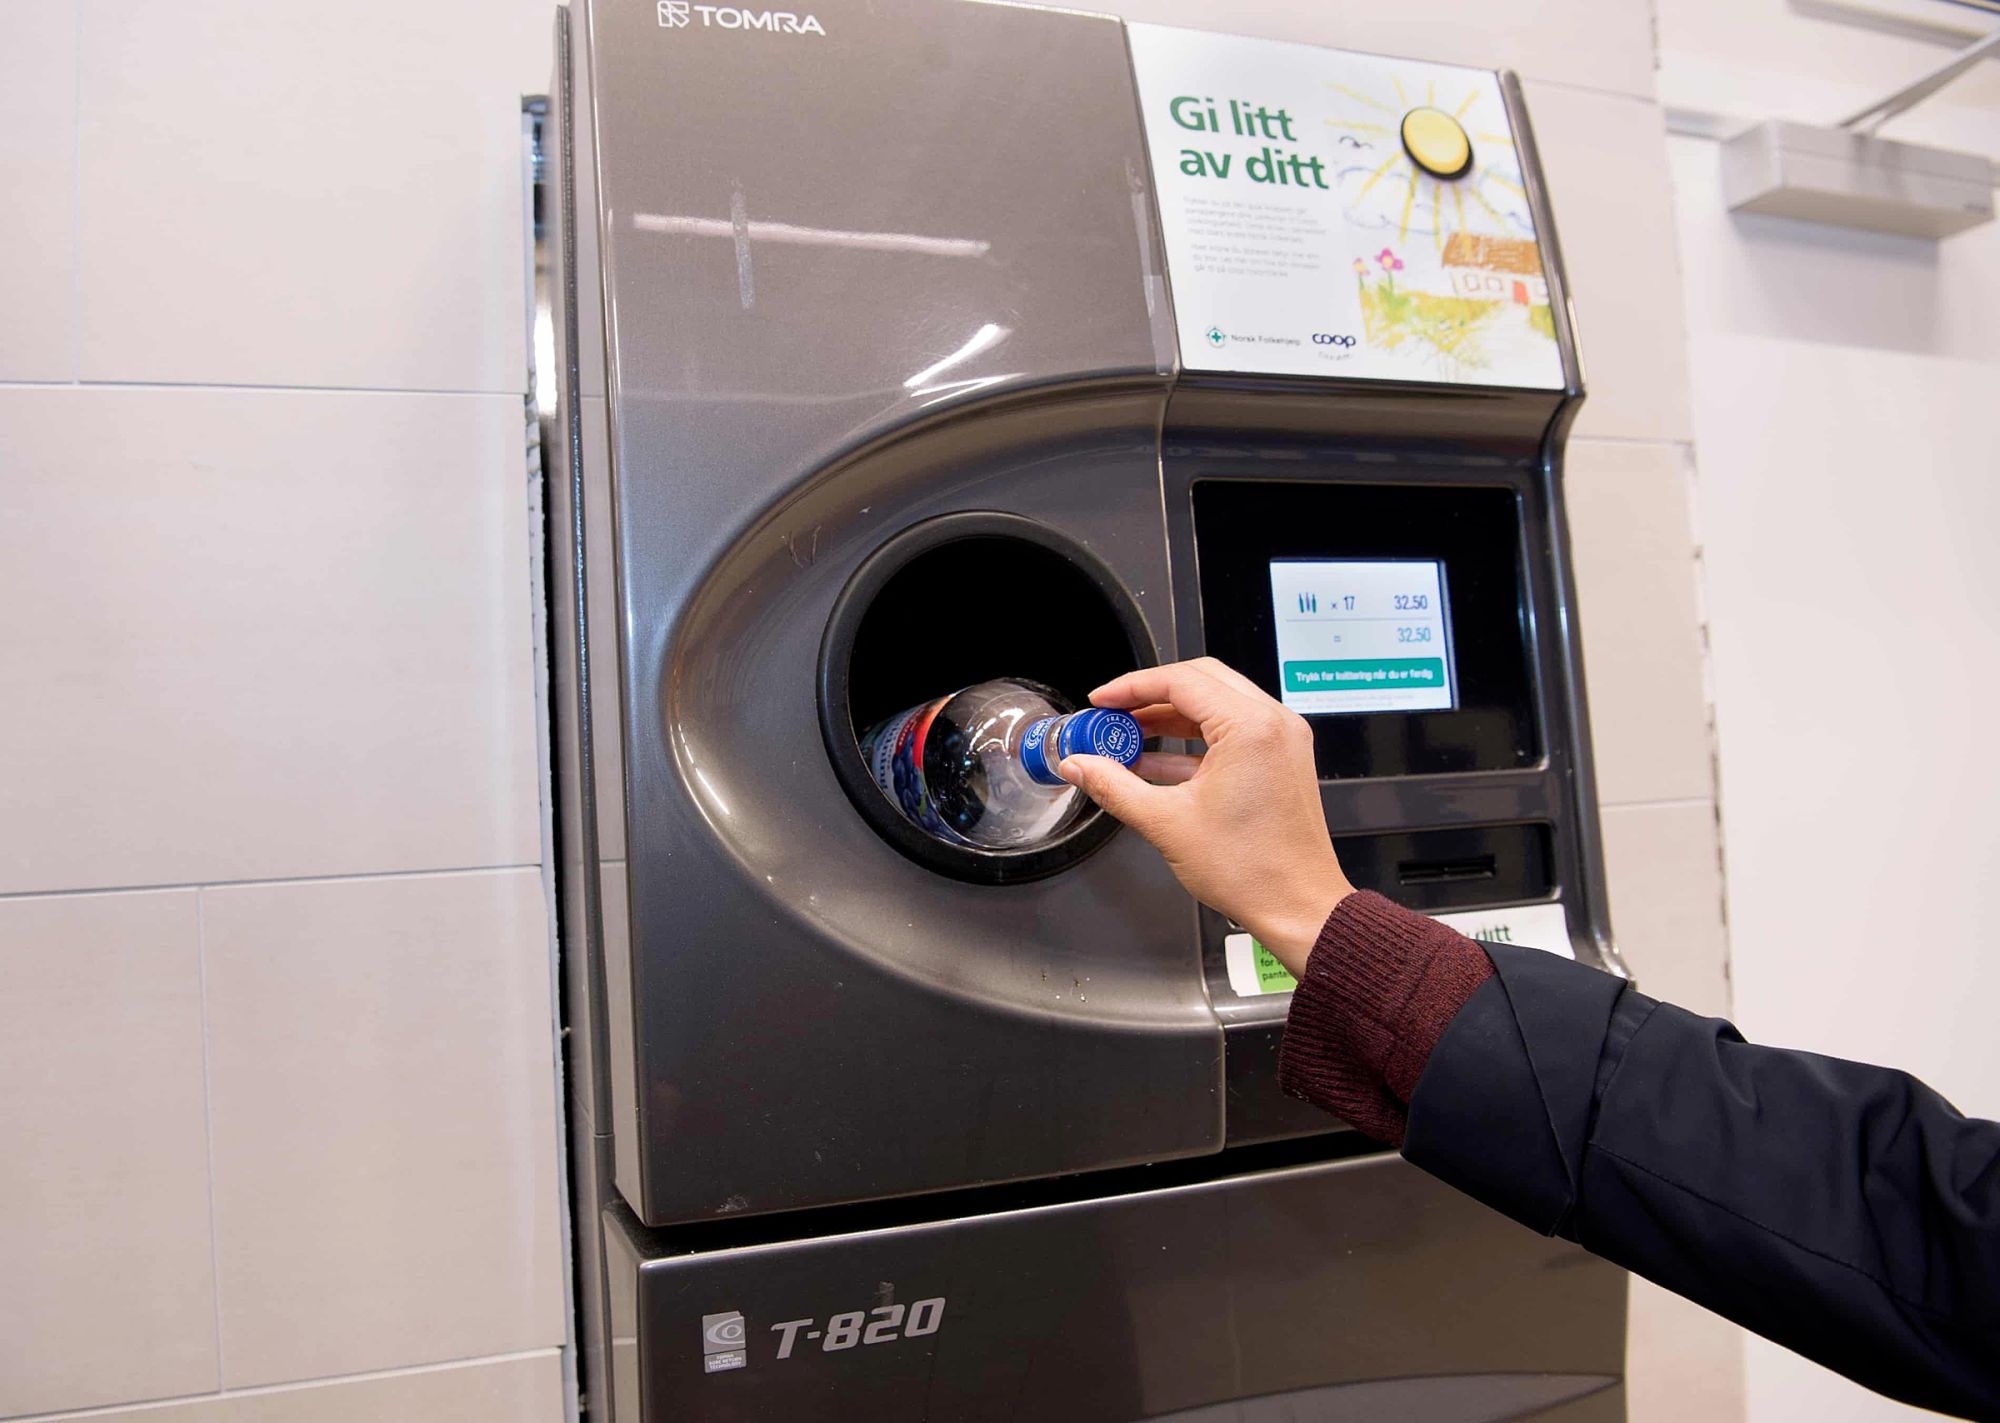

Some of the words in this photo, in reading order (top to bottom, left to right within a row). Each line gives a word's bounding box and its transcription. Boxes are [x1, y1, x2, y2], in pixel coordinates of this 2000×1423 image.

[693, 5, 826, 36] TOMRA
[1170, 95, 1219, 133] Gi
[1229, 99, 1297, 142] litt
[1179, 149, 1231, 179] av
[1246, 147, 1329, 190] ditt
[1312, 333, 1356, 349] coop
[1343, 595, 1355, 611] 17
[1393, 594, 1429, 611] 32.50
[1397, 626, 1432, 643] 32.50
[1321, 671, 1334, 681] for
[1107, 726, 1121, 749] 1907
[1260, 958, 1274, 967] for
[770, 1297, 946, 1359] T-820
